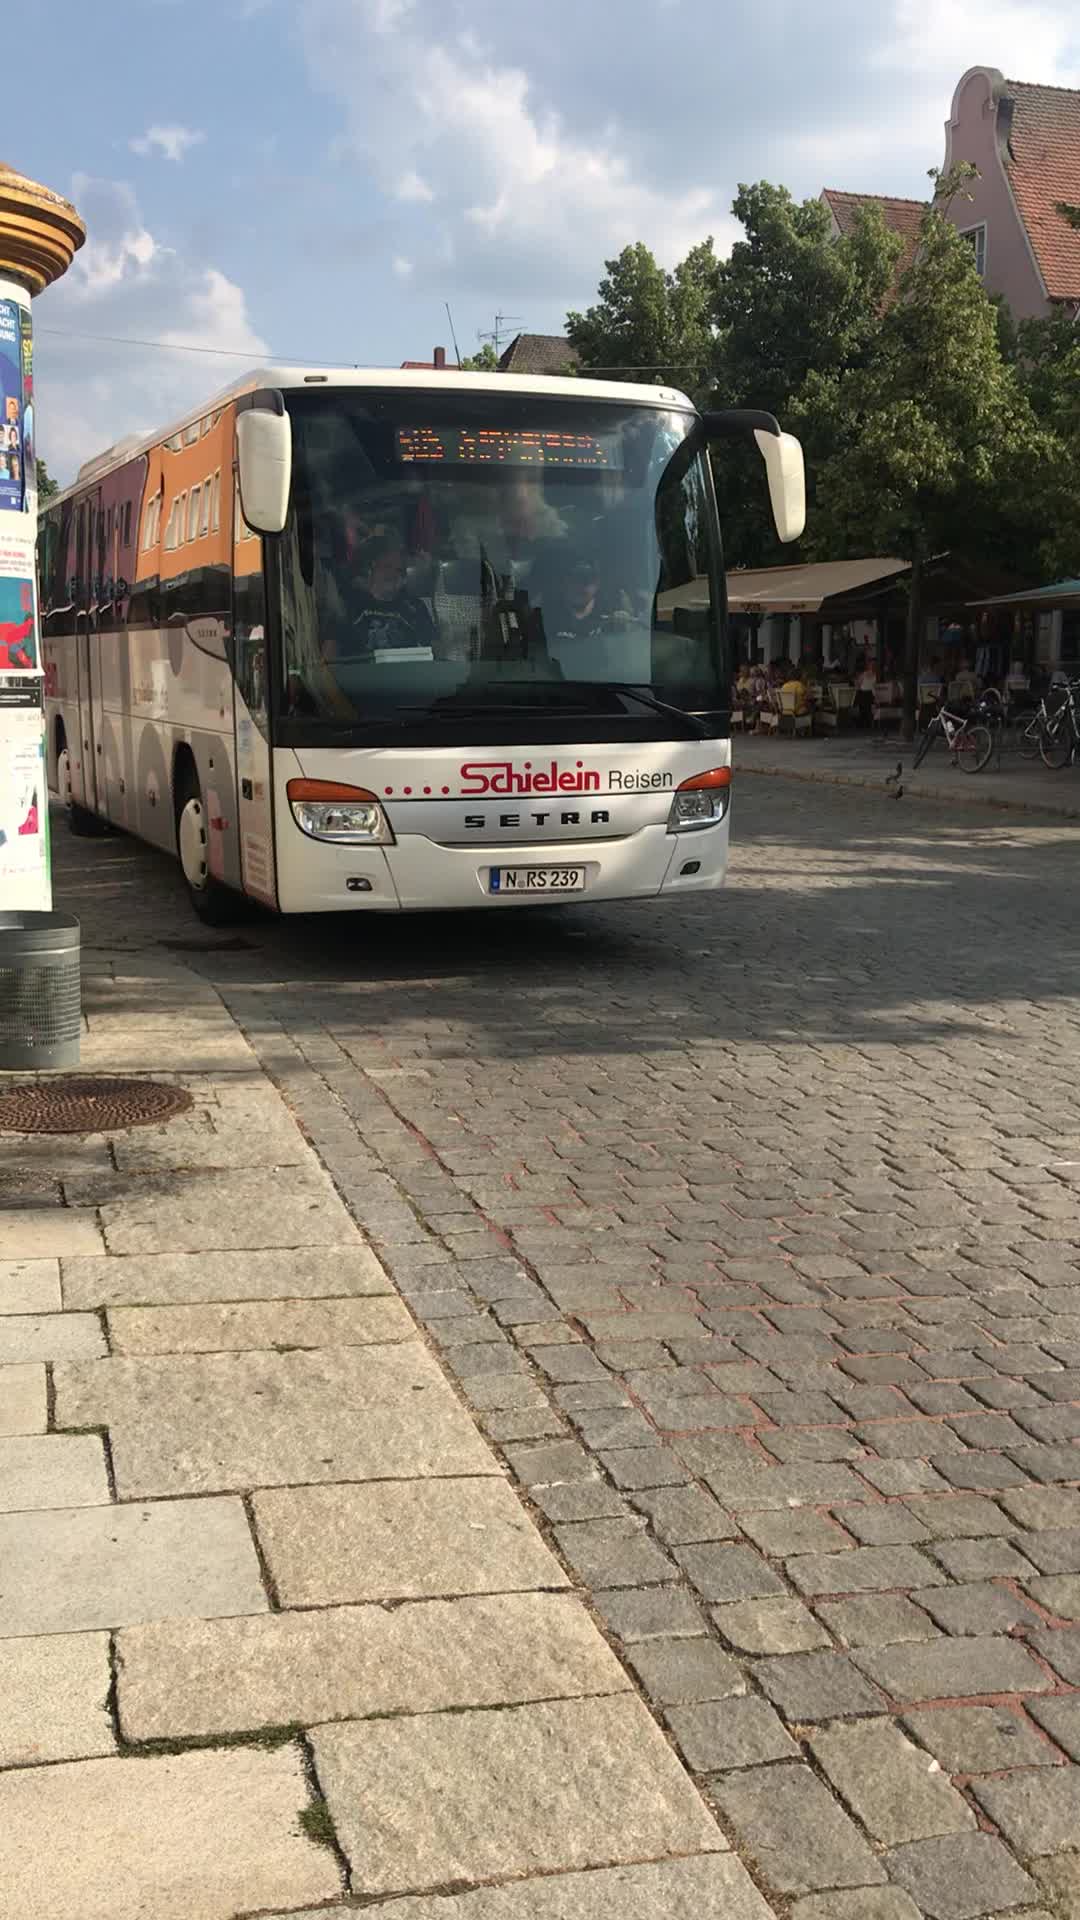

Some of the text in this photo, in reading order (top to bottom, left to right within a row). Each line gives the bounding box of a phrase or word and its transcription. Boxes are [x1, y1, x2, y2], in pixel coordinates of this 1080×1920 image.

[461, 761, 673, 794] Schielein Reisen
[464, 811, 610, 828] SETRA
[550, 870, 579, 887] 239
